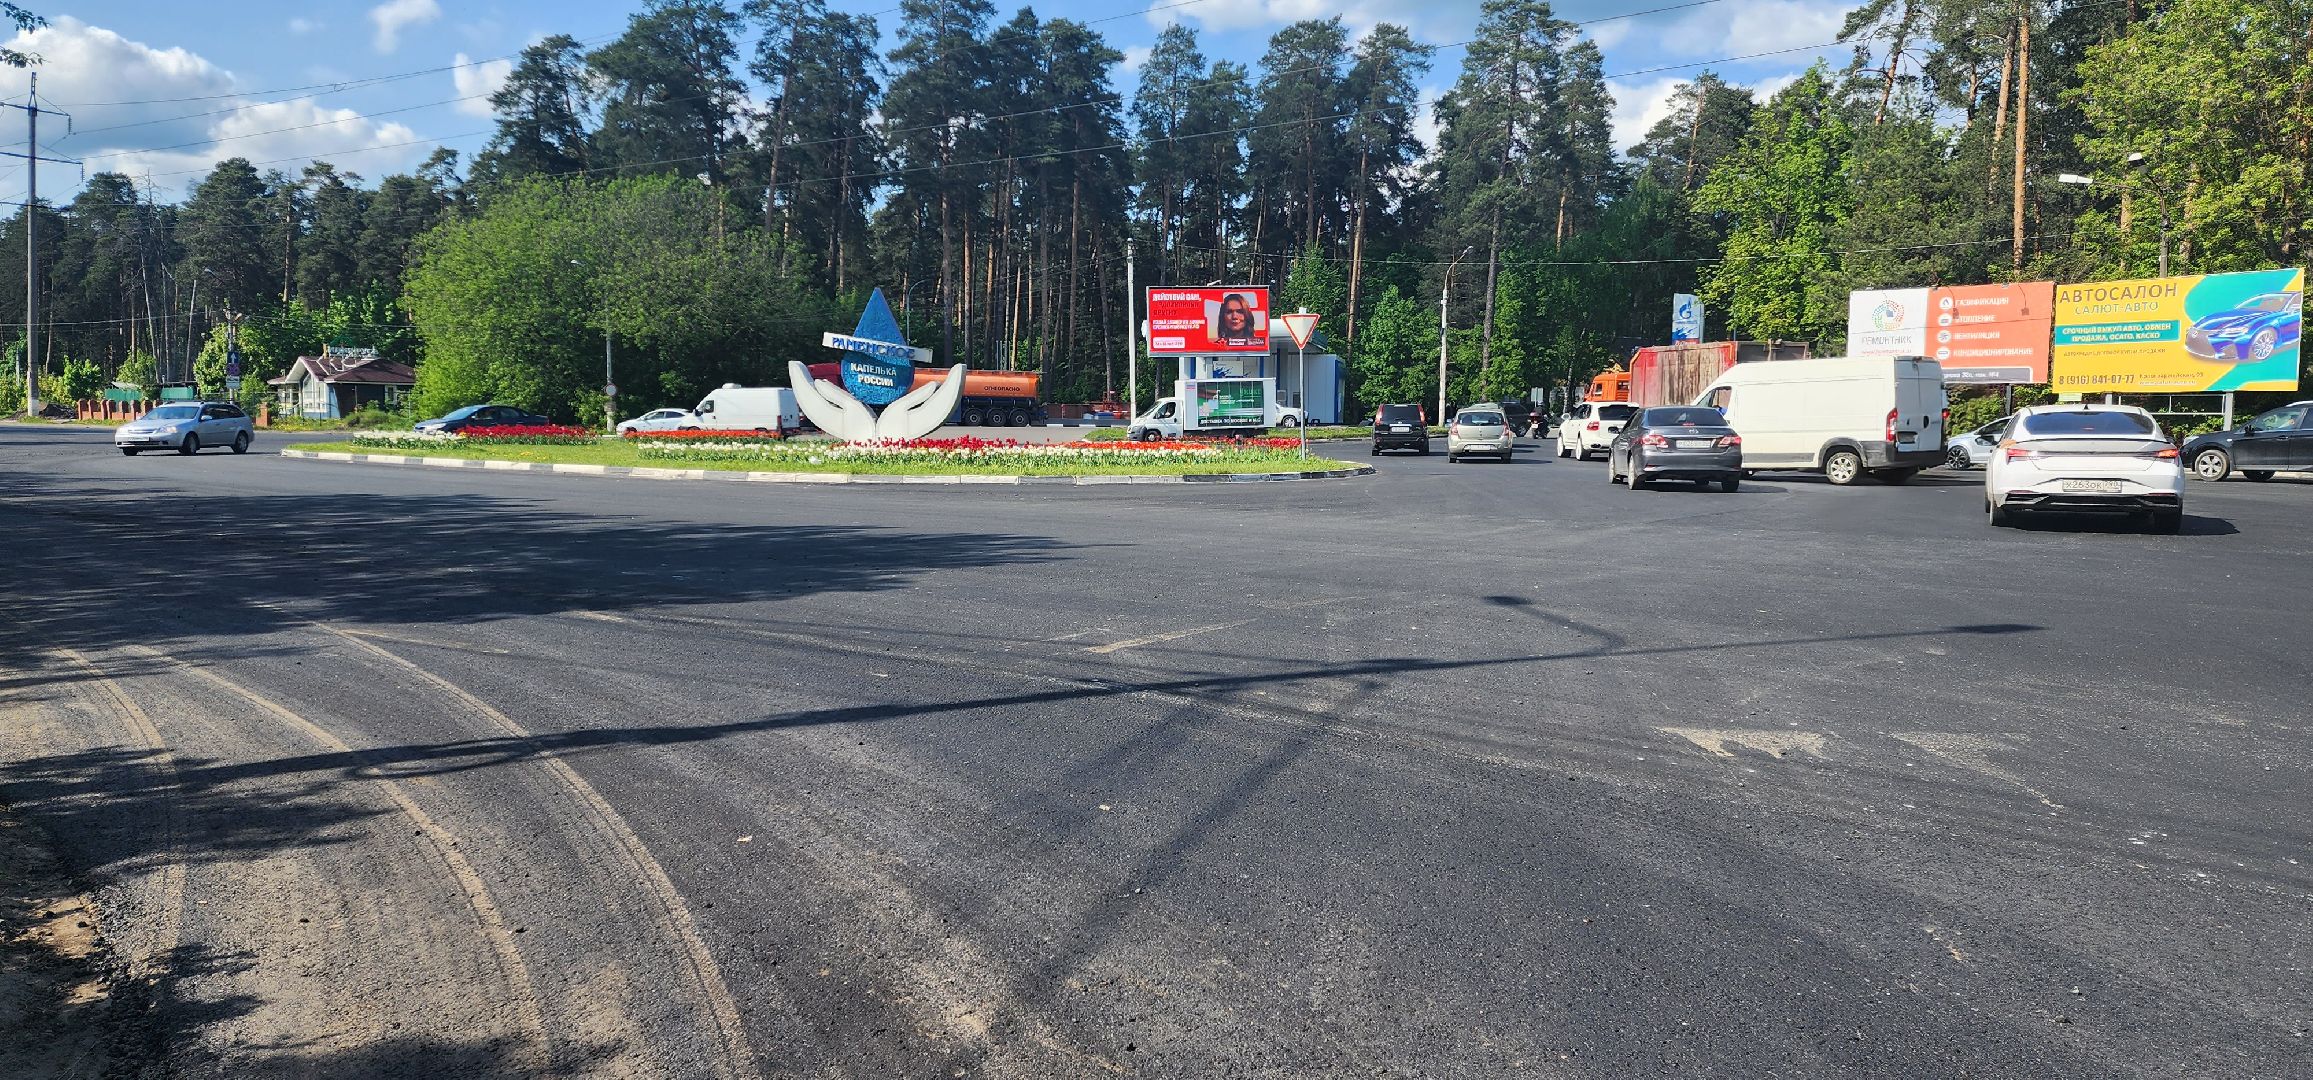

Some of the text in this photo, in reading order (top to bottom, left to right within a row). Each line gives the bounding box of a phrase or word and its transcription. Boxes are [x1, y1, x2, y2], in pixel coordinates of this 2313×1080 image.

[2059, 282, 2178, 303] АВТОСАЛОН
[1955, 297, 2009, 306] ГАЗИФИКАЦИЯ
[2075, 301, 2159, 315] САЛЮТ-АВТО
[1955, 314, 1997, 323] ОТОПЛЕНИЕ
[2062, 326, 2097, 335] СРОЧНЫЙ
[2097, 326, 2123, 334] ВЫКУП
[2144, 323, 2171, 331] ОБМЕН
[1952, 331, 2000, 340] ВЕНТИЛЯЦИЯ
[832, 337, 916, 359] РАМЕНСКОЕ
[1953, 347, 2033, 357] КОНДИЦИОНИРОВАНИЕ
[850, 362, 897, 376] КАПЕЛЬКА
[858, 374, 894, 387] РОССИИ
[2059, 374, 2134, 385] 8 (916) 841-07-77
